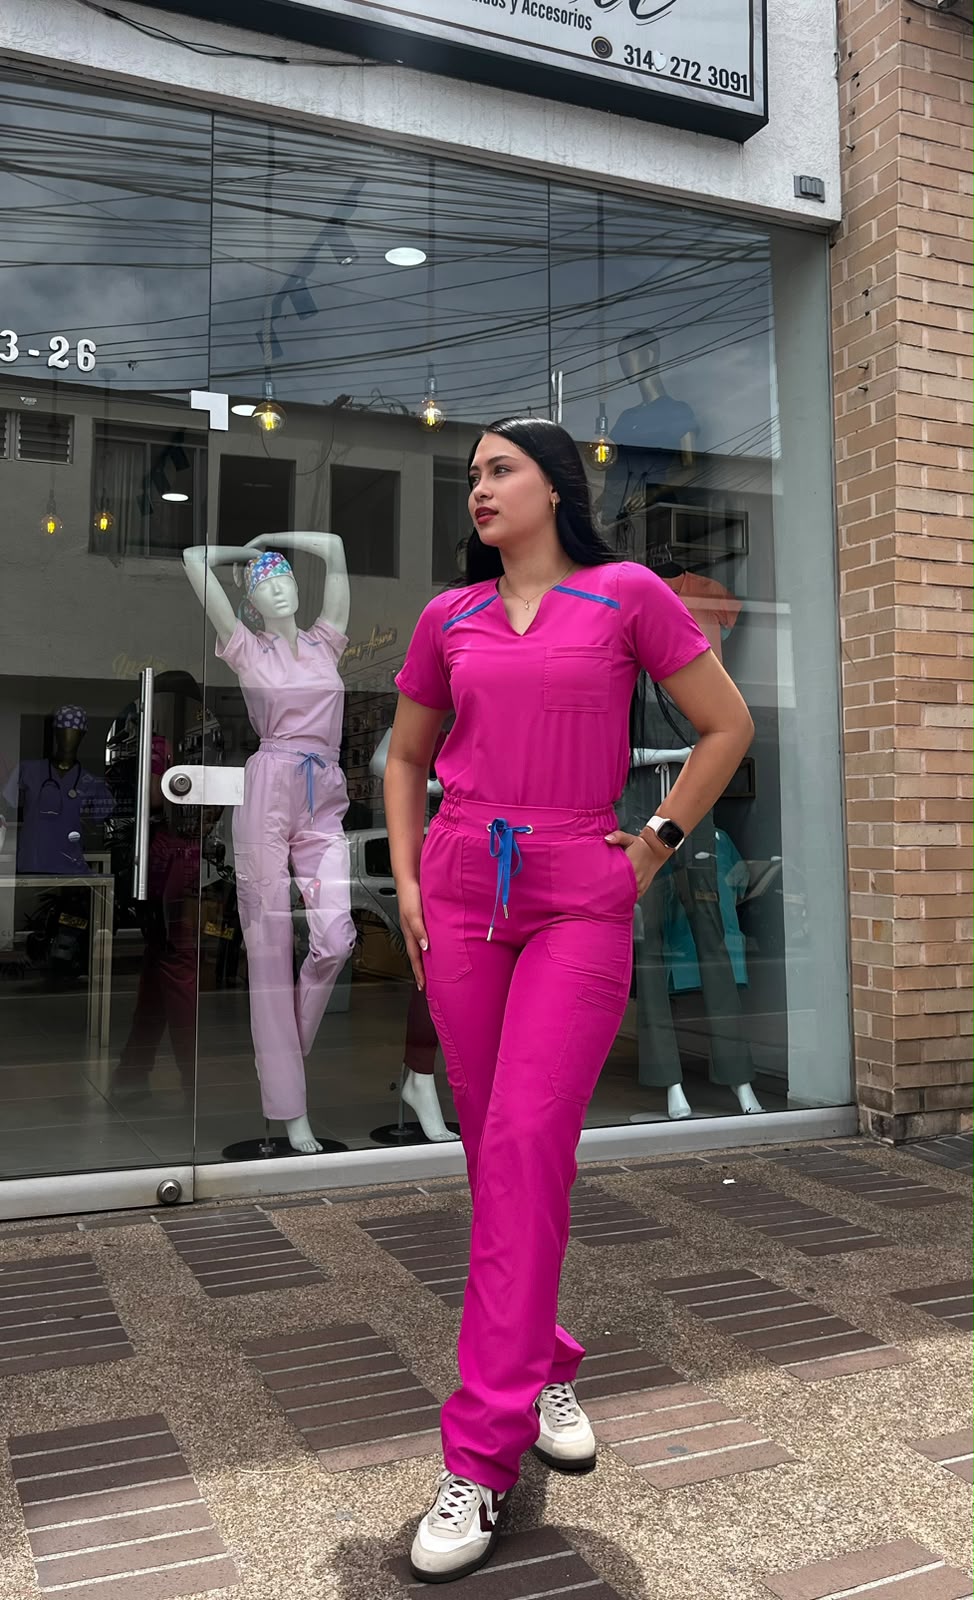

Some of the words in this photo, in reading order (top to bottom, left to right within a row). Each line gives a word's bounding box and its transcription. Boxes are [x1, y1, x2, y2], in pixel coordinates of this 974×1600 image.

[510, 0, 518, 15] y
[520, 0, 593, 31] Accesorios
[623, 44, 654, 70] 314
[670, 56, 702, 82] 272
[707, 65, 748, 94] 3091
